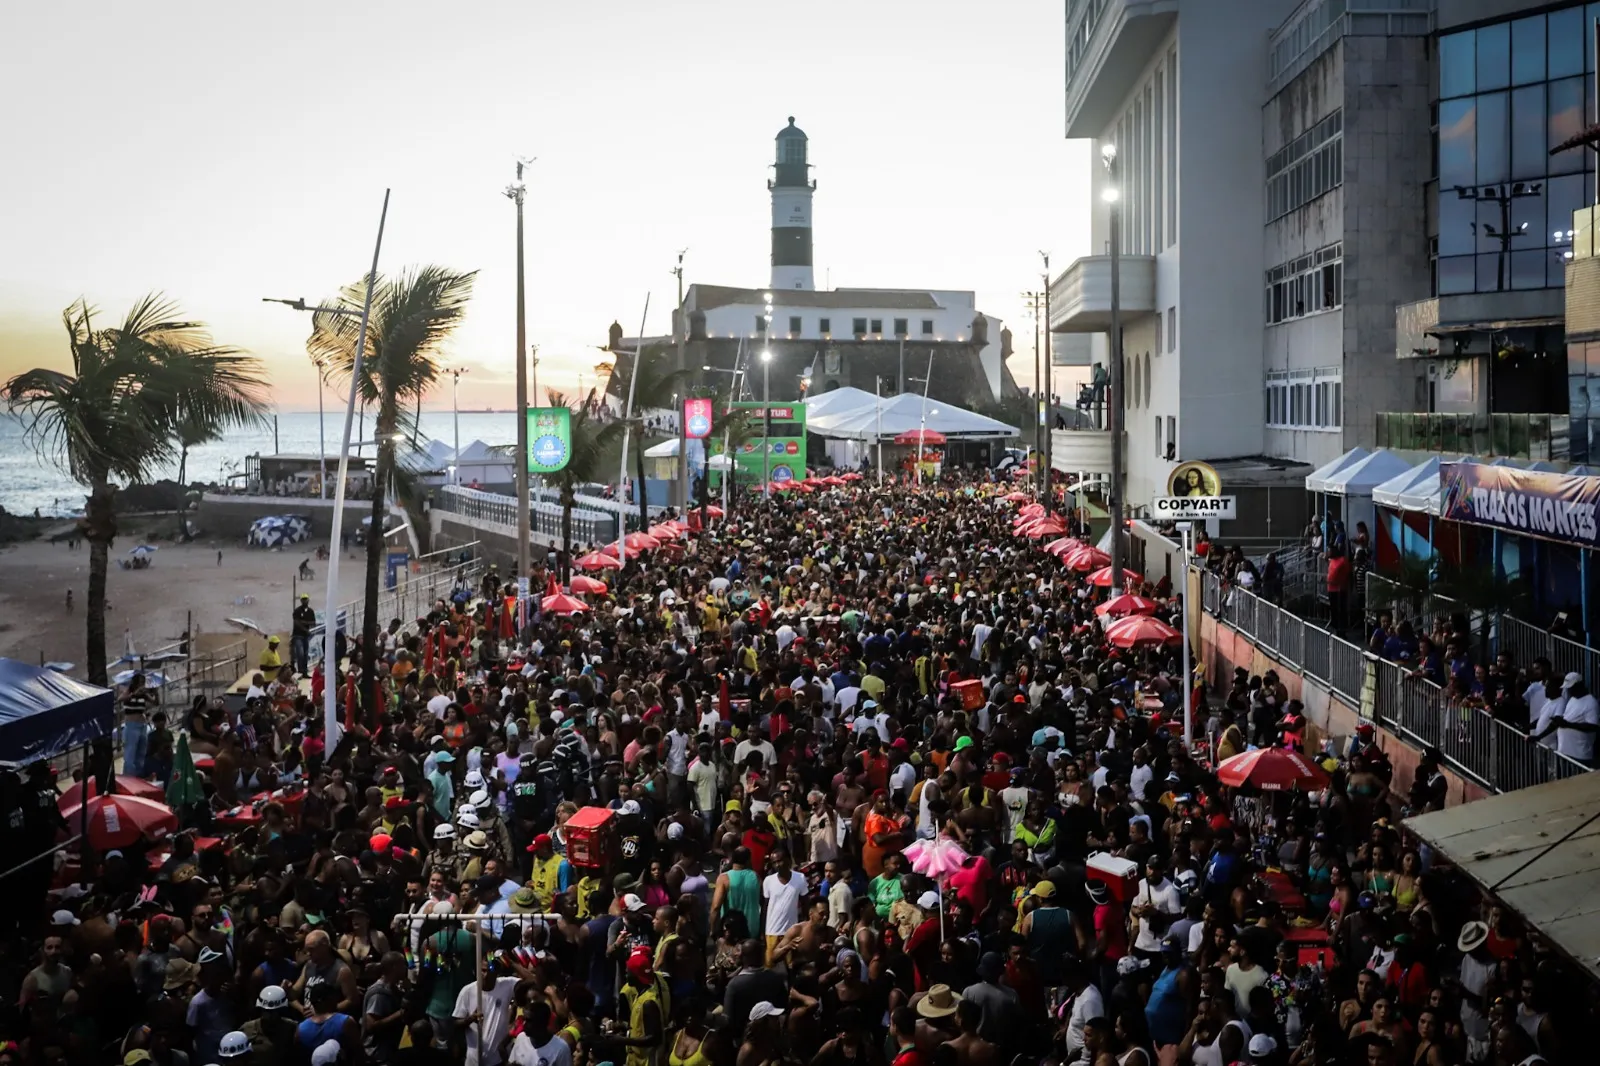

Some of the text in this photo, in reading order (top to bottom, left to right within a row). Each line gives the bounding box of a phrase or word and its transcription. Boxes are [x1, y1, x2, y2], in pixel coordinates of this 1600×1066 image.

[755, 408, 787, 417] SATUR
[1158, 498, 1231, 510] COPYART
[1528, 495, 1597, 541] MONTES
